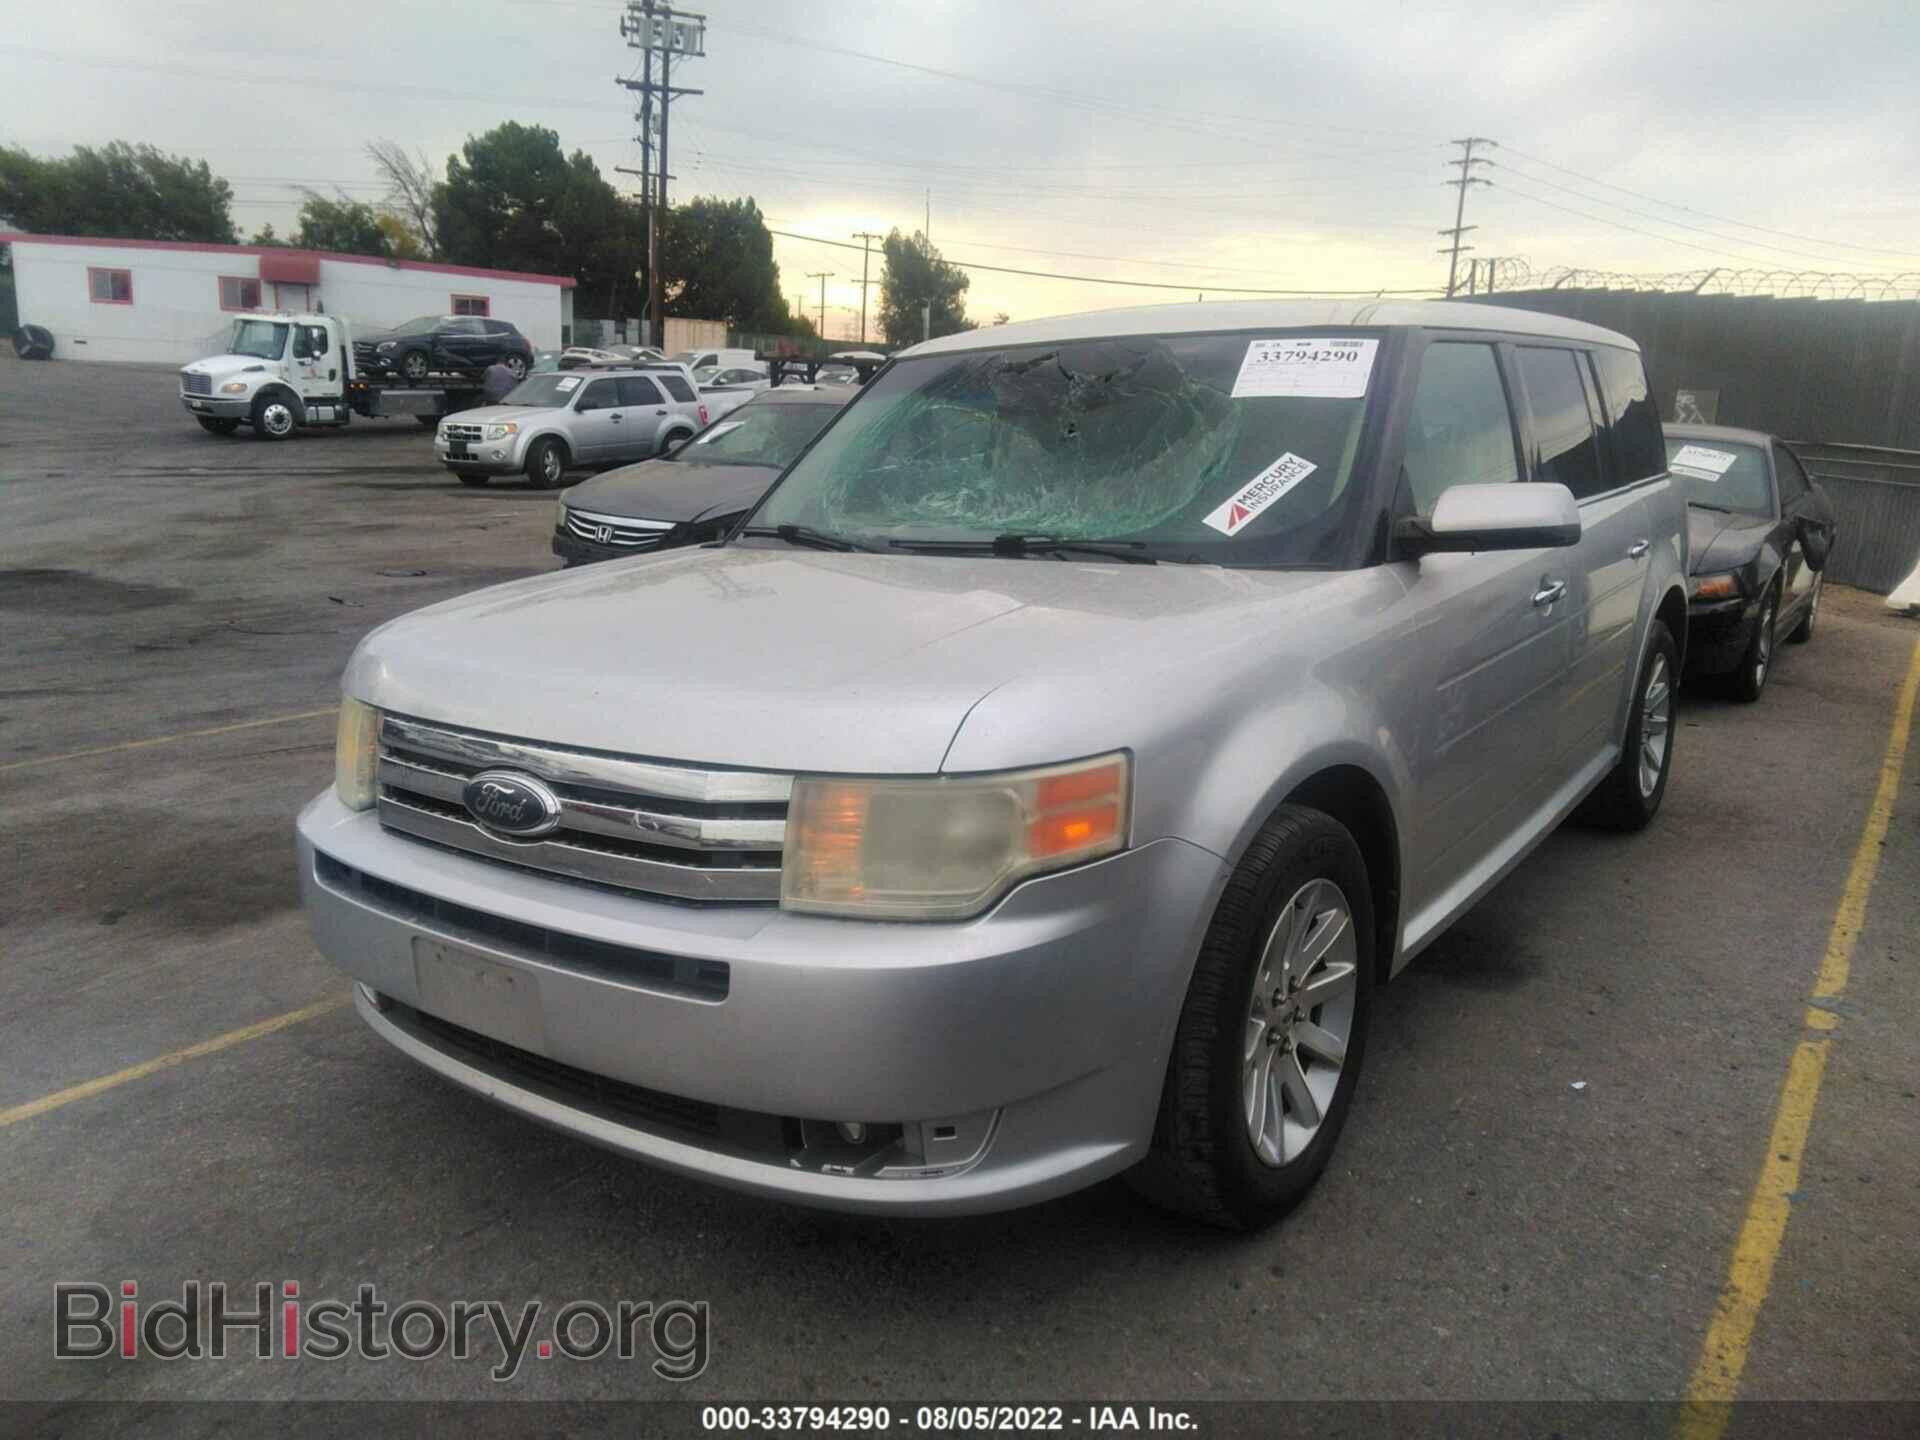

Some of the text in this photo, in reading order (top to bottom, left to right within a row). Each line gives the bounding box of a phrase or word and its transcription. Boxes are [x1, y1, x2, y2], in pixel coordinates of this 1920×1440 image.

[1256, 350, 1359, 363] 33794290
[1237, 456, 1297, 505] MERCURY
[1247, 461, 1309, 511] INSURANCE
[474, 782, 527, 822] Ford
